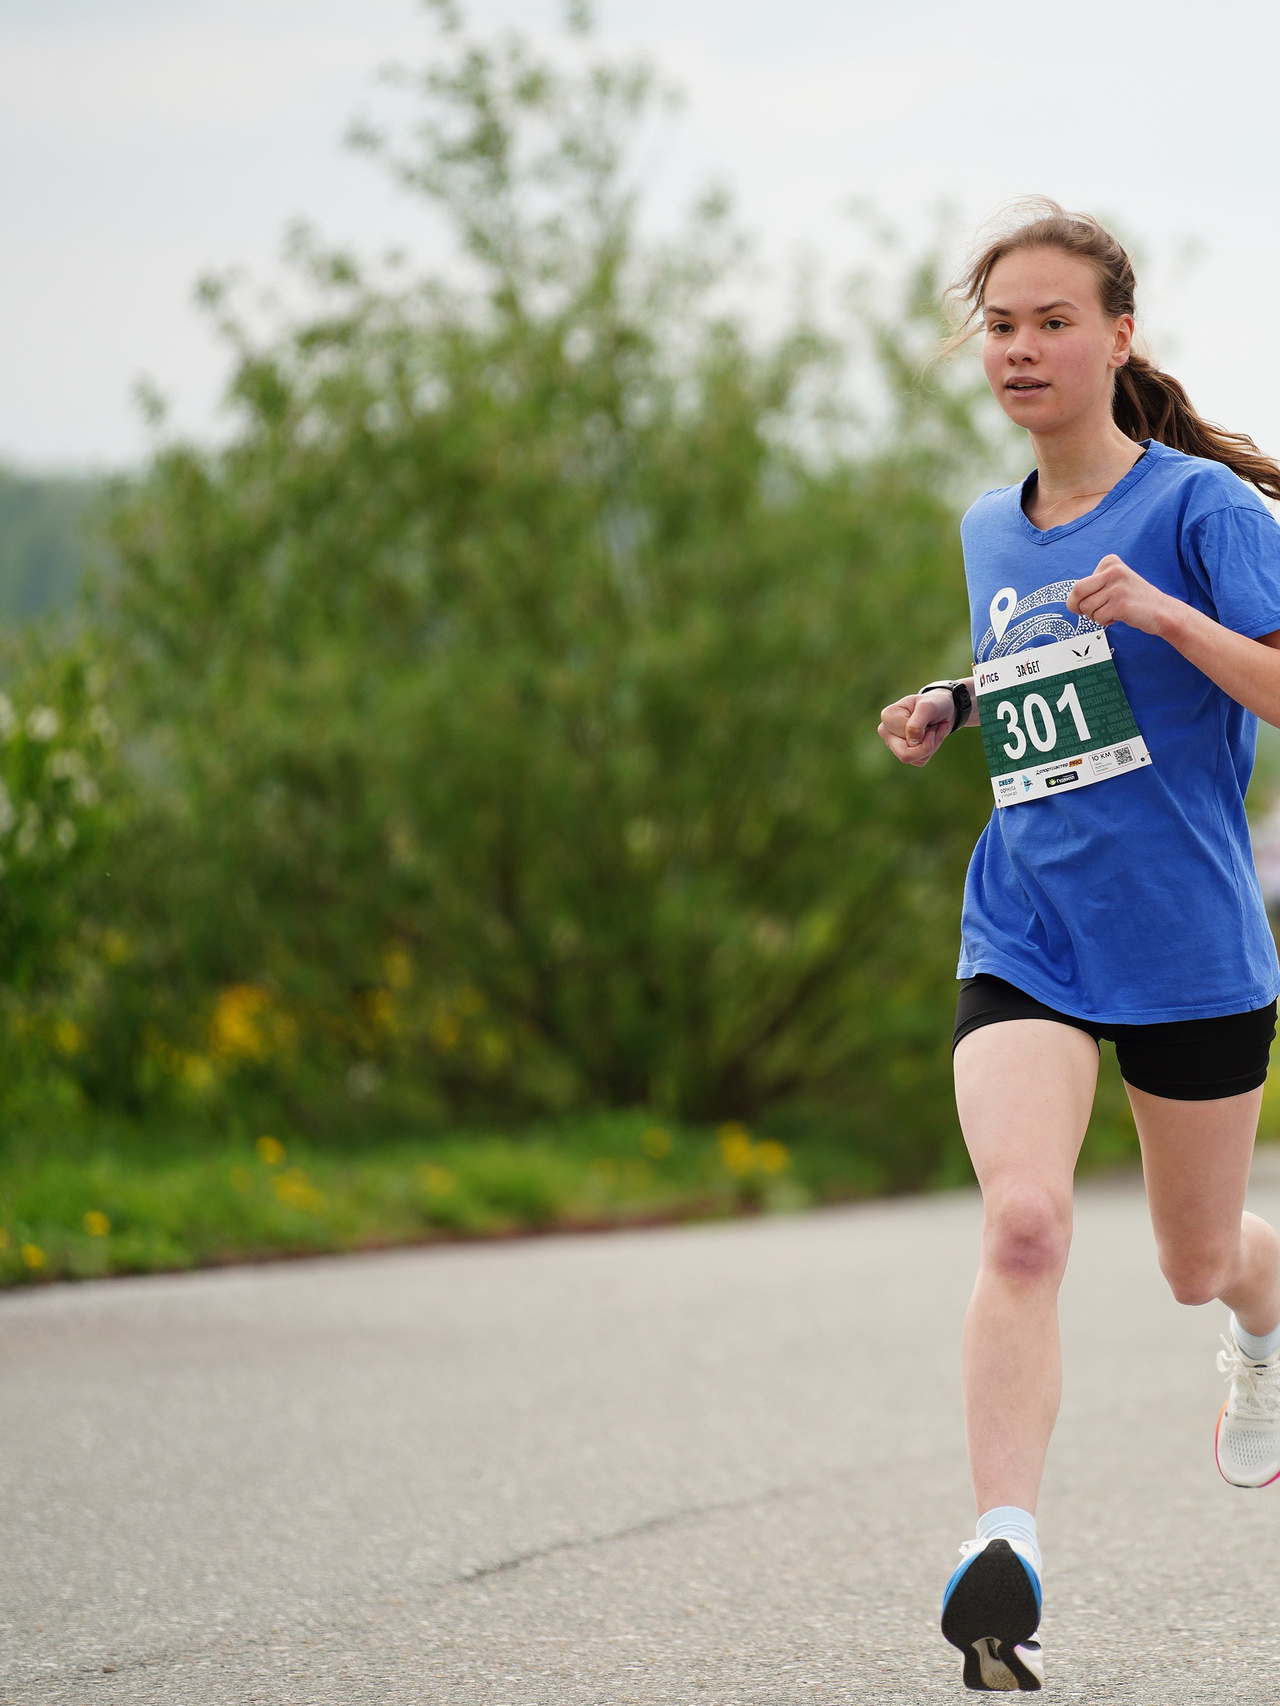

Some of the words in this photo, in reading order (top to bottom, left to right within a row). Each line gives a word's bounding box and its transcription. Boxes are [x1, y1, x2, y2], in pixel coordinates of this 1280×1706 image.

[986, 673, 1000, 684] ПСБ
[996, 682, 1091, 760] 301
[1091, 754, 1100, 762] 10
